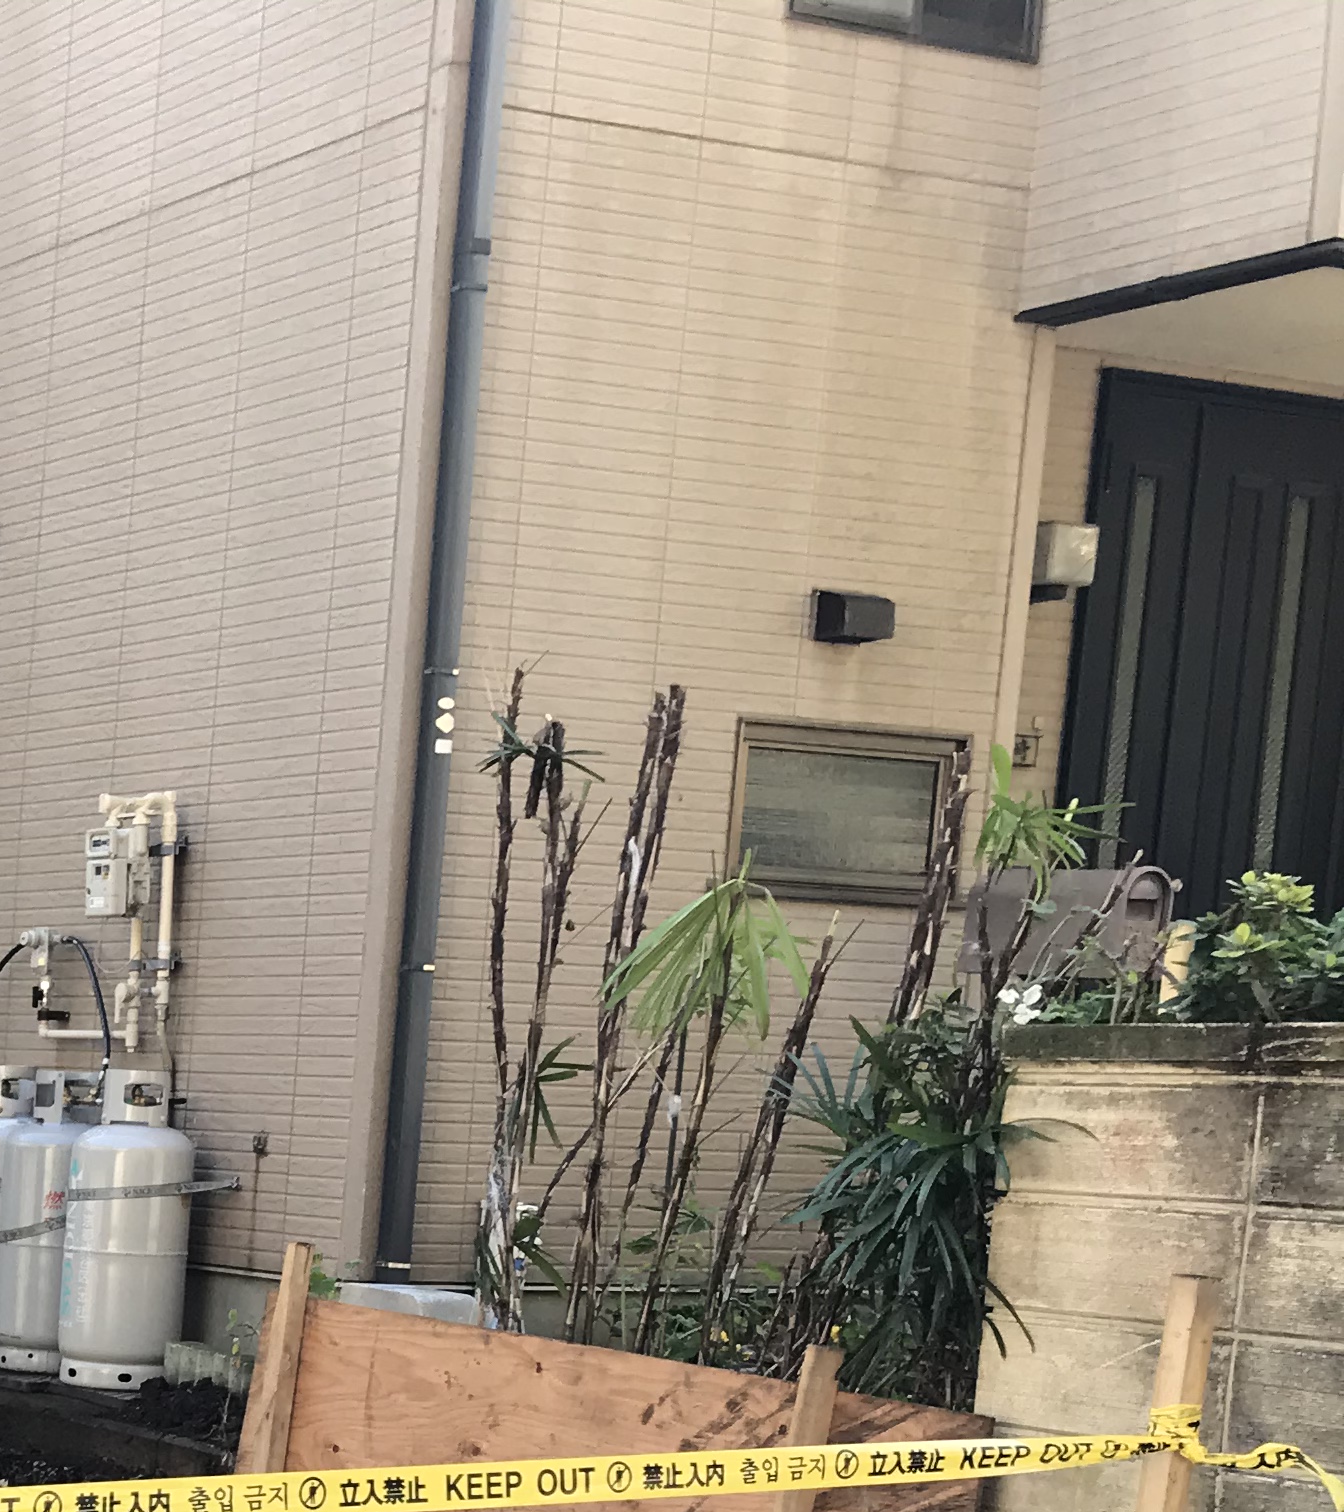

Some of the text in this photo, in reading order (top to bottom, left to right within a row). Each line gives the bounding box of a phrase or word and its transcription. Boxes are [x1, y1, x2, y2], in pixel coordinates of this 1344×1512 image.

[244, 1482, 288, 1512] 금지
[339, 1476, 428, 1507] 立入禁止
[446, 1471, 522, 1501] KEEP
[537, 1467, 595, 1496] OUT
[643, 1460, 724, 1490] 禁止入内
[740, 1456, 778, 1484] 출입
[790, 1456, 825, 1481] 금지
[868, 1451, 946, 1477] 立入禁止
[959, 1446, 1031, 1470] KEEP
